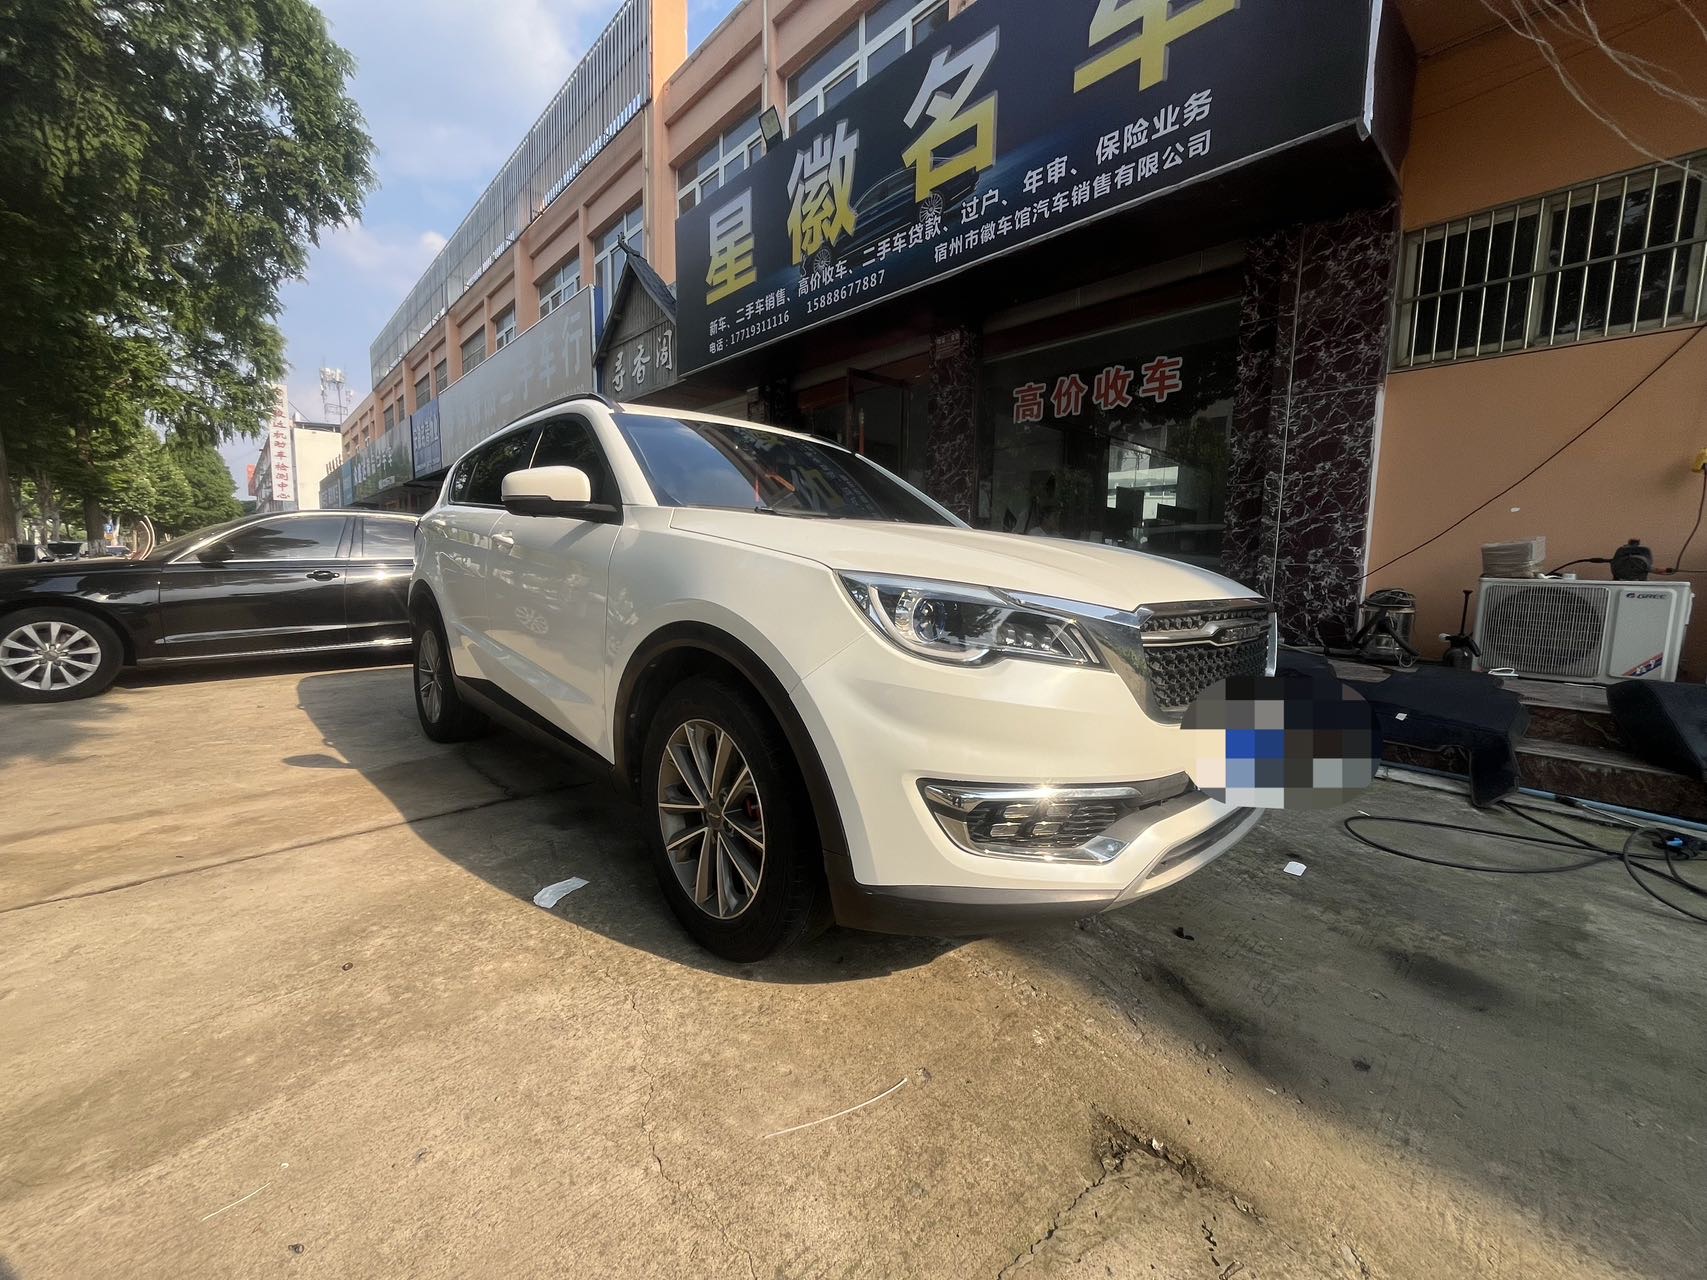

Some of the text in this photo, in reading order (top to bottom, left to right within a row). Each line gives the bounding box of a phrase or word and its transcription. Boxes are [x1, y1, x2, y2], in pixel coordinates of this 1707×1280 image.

[934, 129, 1212, 264] 宿州市徽车馆汽车销售有限公司
[806, 269, 886, 314] 15888677887
[612, 329, 673, 392] 寻香阁
[1013, 356, 1183, 424] 高价收车
